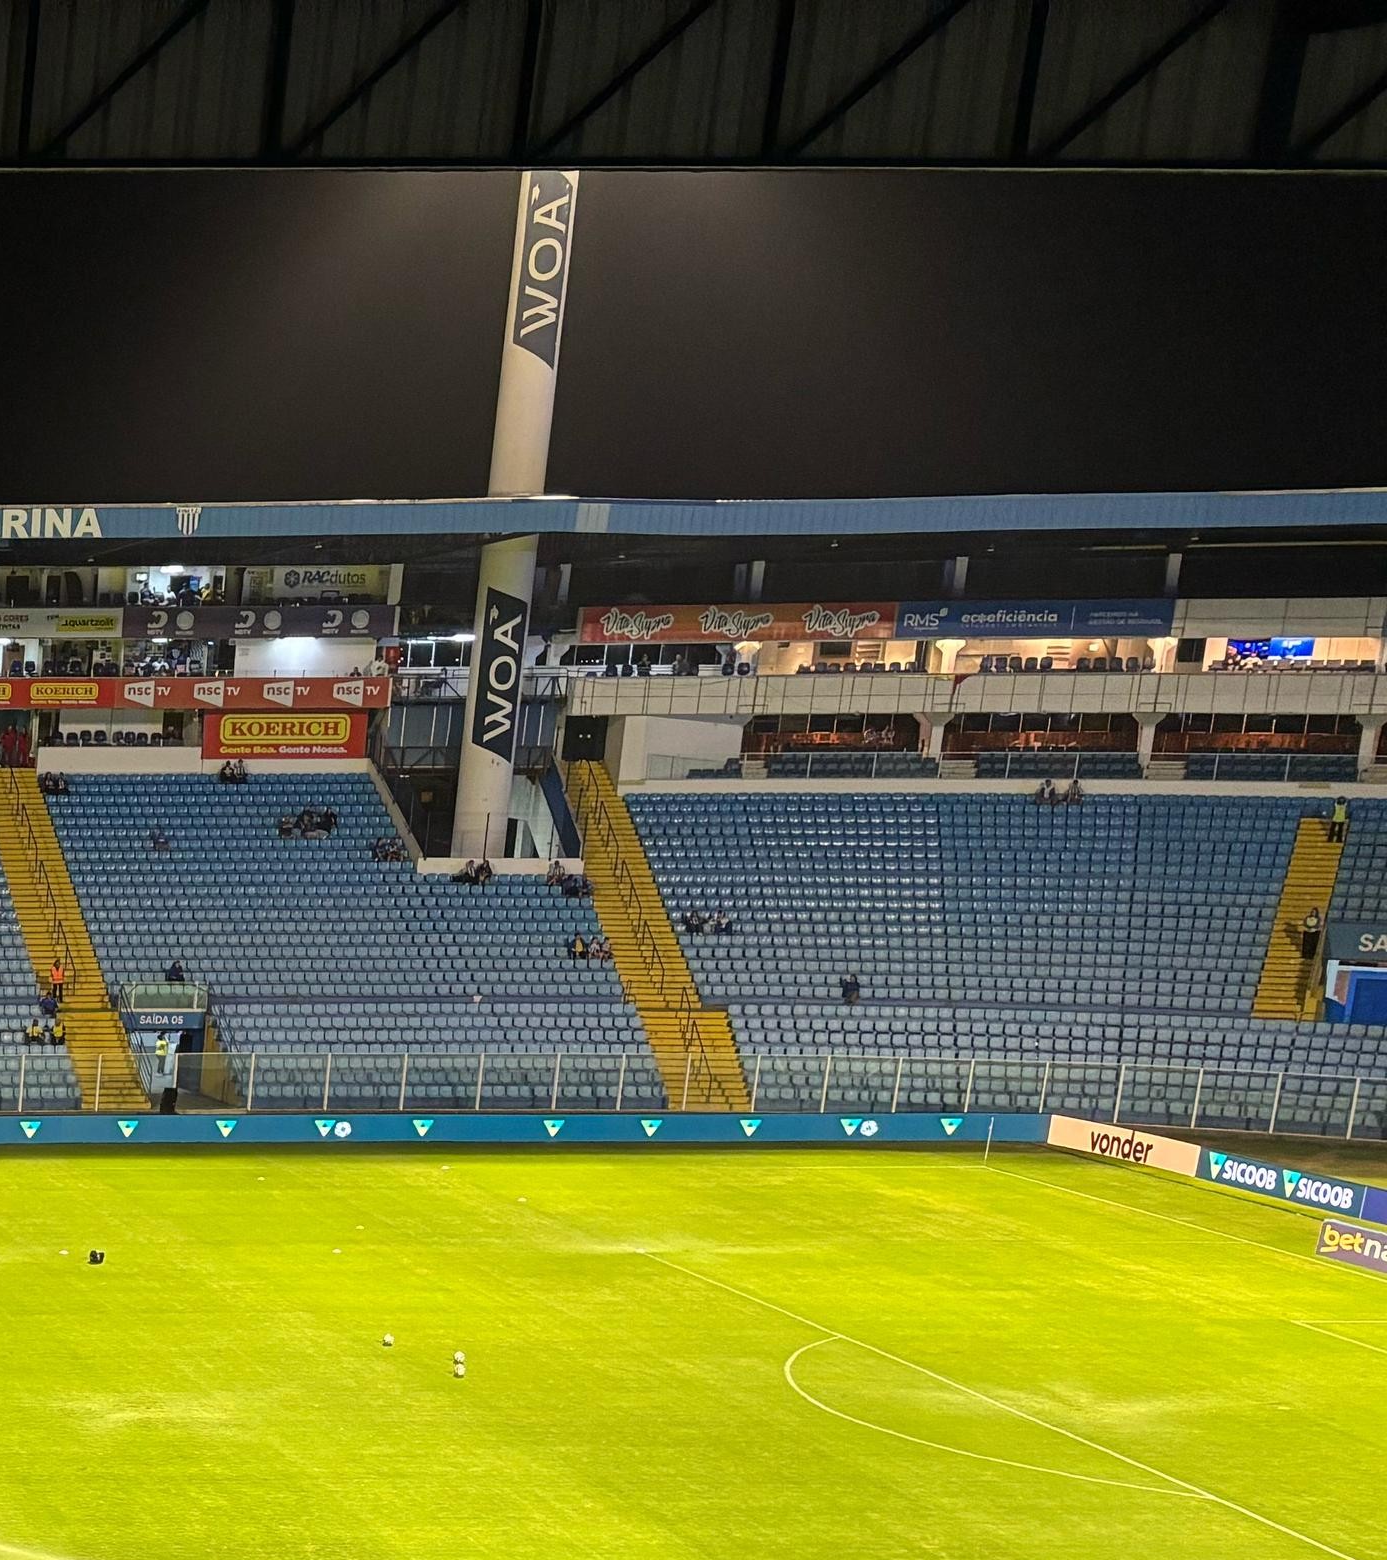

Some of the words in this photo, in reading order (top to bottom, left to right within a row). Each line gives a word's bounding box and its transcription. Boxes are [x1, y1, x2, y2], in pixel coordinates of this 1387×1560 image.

[520, 194, 569, 338] WOA
[903, 613, 940, 627] RMS
[482, 613, 523, 743] WOA
[35, 686, 93, 696] KOERICH
[128, 686, 152, 696] nsc
[157, 686, 171, 696] TV
[197, 686, 222, 696] nsc
[227, 686, 241, 696] TV
[266, 686, 291, 696] nsc
[296, 686, 310, 696] TV
[336, 686, 361, 696] nsc
[365, 686, 380, 696] TV
[228, 721, 341, 737] KOERICH
[220, 745, 251, 754] Gente
[279, 745, 311, 754] Gente
[312, 745, 348, 754] Nossa.
[139, 1012, 170, 1025] SAÍDA
[171, 1015, 184, 1025] 05
[1090, 1129, 1153, 1163] vonder
[1221, 1159, 1278, 1191] SICOOB
[1295, 1176, 1354, 1209] SICOOB
